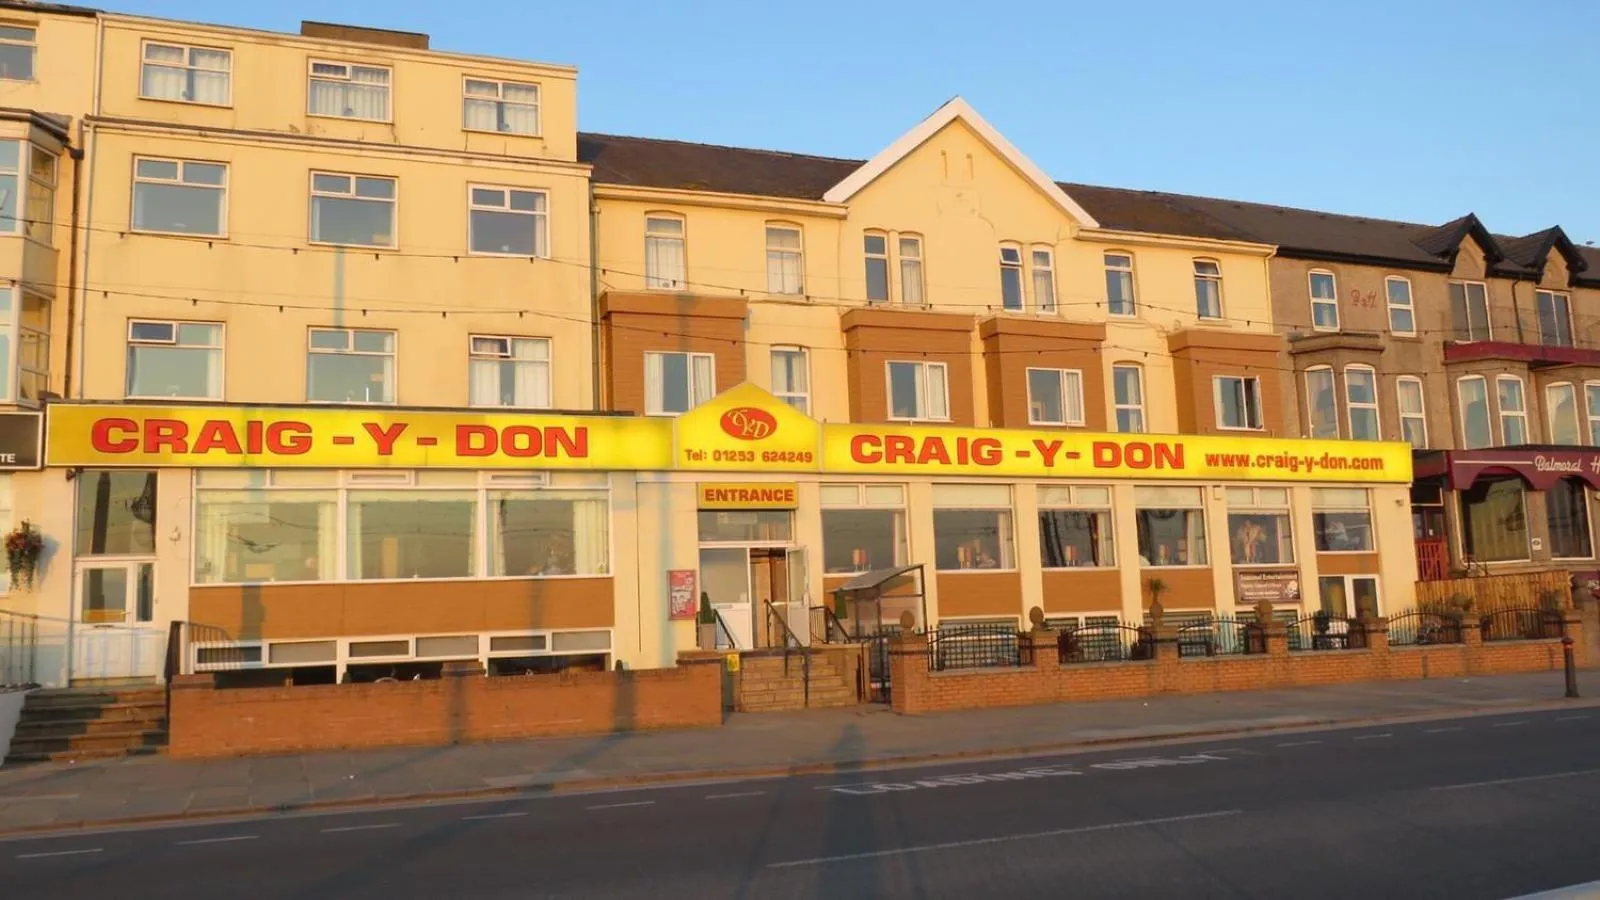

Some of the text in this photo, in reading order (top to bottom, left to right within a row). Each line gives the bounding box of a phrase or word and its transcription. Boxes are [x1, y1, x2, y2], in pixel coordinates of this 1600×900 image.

[90, 417, 313, 455] CRAIG
[455, 425, 589, 458] DON
[685, 449, 813, 464] Tel: 01253 624249
[850, 434, 1003, 466] CRAIG
[1093, 442, 1185, 470] DON
[1204, 453, 1384, 474] www.craig-y-don.com
[1534, 455, 1583, 472] Balmoral
[704, 488, 794, 503] ENTRANCE
[831, 769, 1084, 795] LOADING
